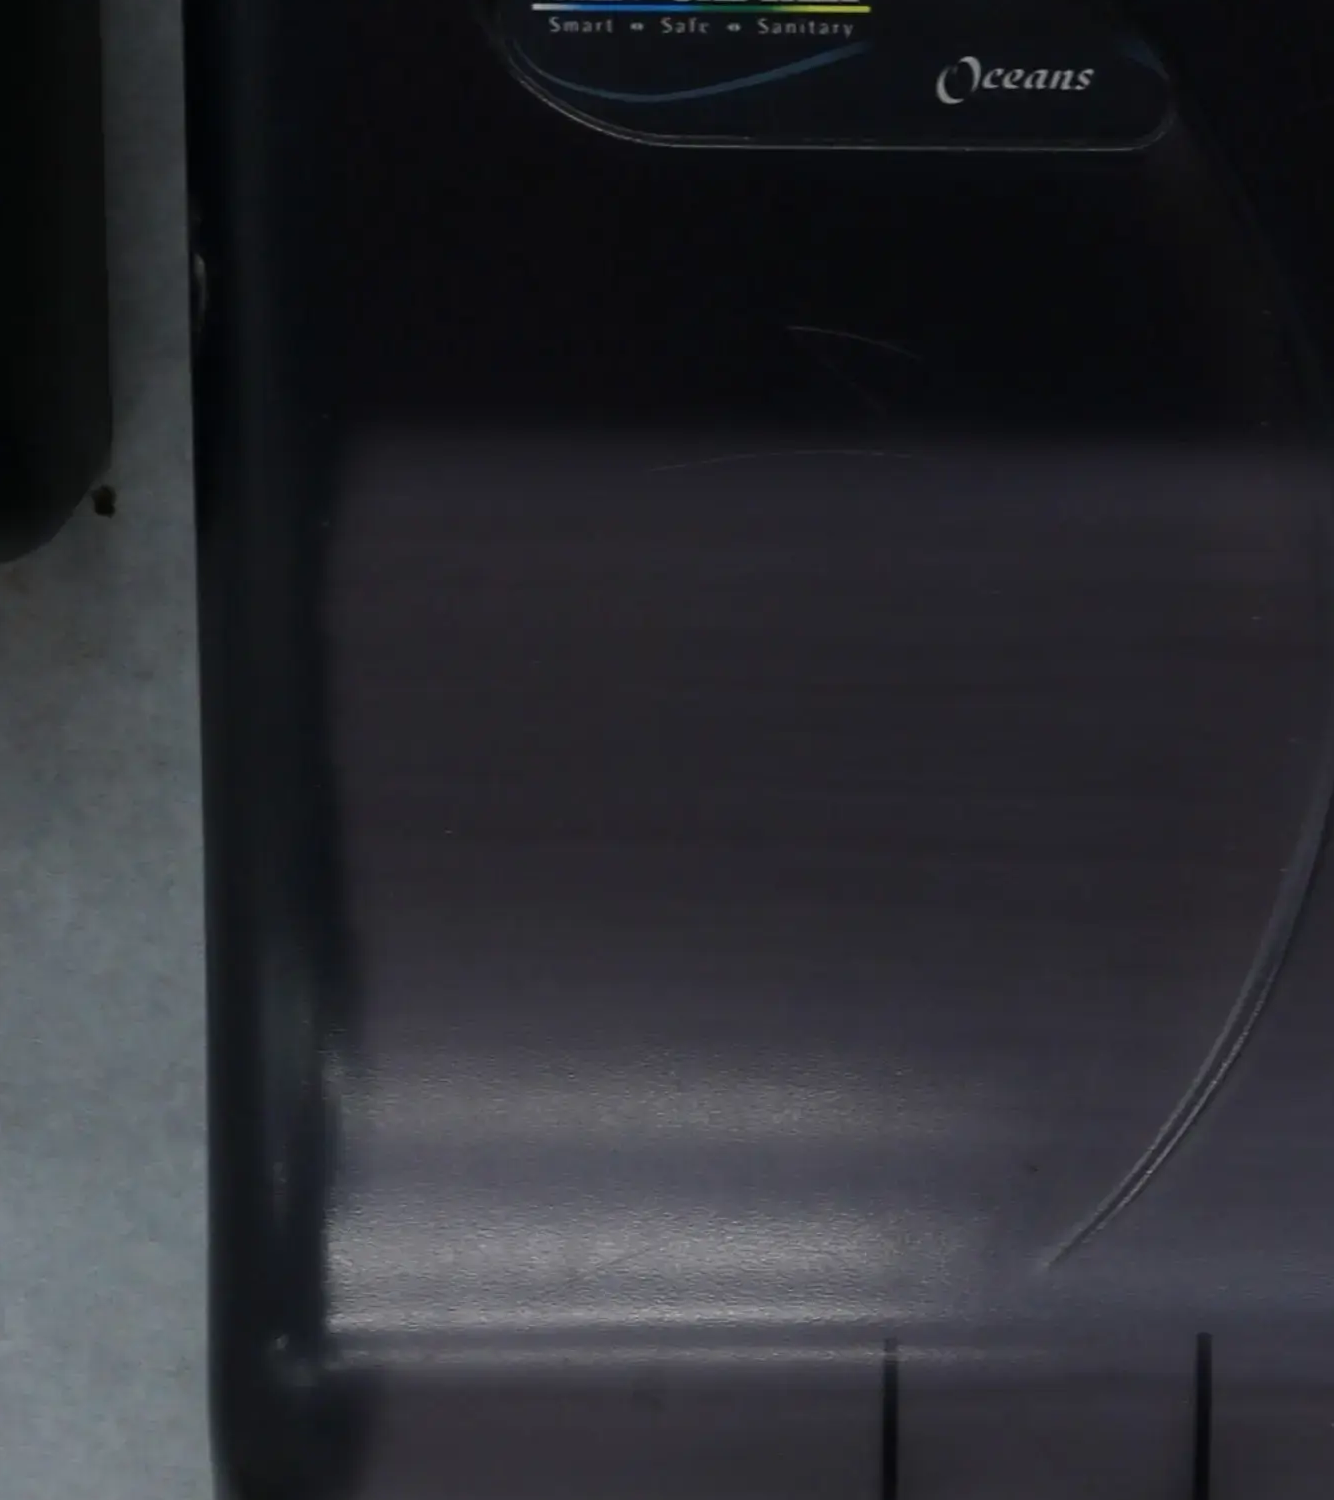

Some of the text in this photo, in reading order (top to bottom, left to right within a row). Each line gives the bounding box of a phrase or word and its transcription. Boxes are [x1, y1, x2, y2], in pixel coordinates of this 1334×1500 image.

[549, 16, 855, 39] Smart Safe Sanitary
[935, 55, 1095, 105] Oceans
